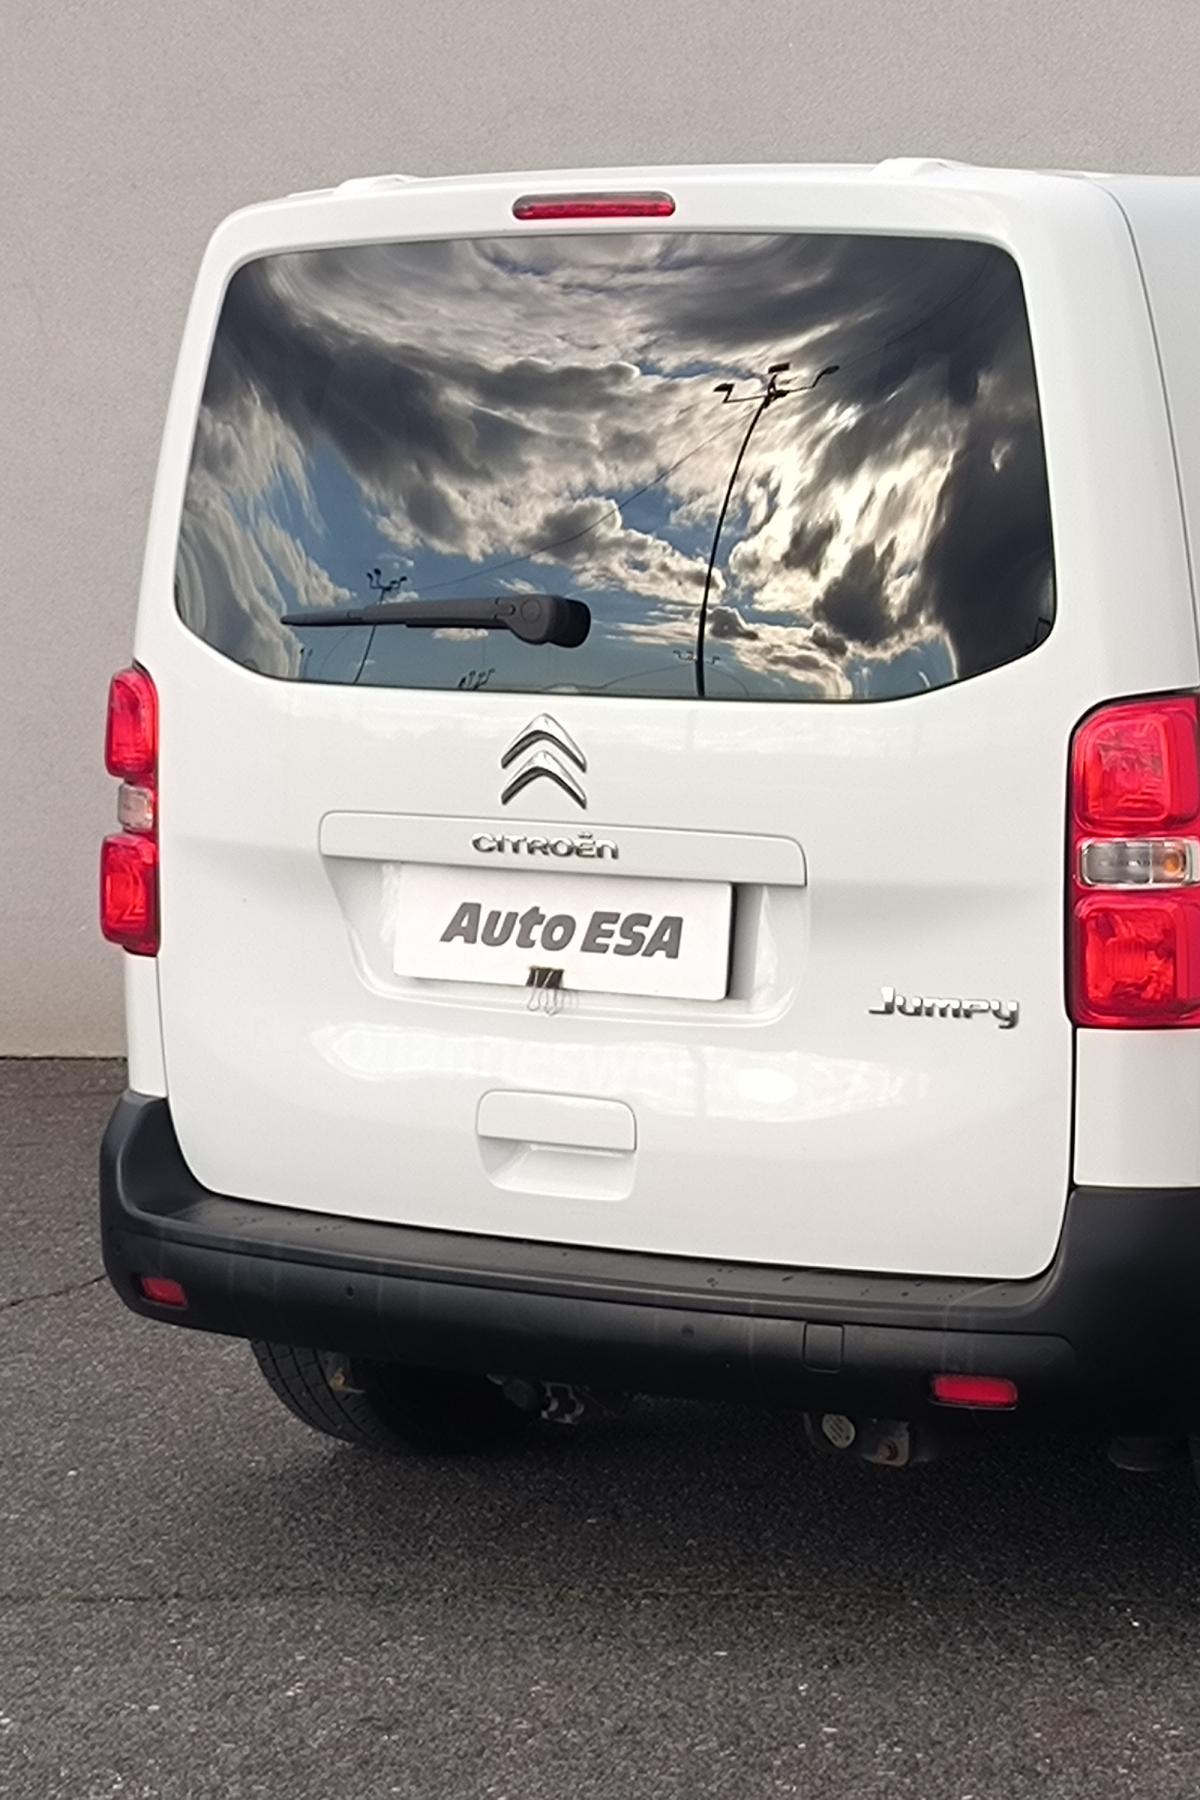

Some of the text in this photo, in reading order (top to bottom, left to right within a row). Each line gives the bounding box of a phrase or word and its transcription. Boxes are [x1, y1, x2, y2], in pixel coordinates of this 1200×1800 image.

[439, 902, 683, 959] Auto ESA
[868, 986, 1019, 1030] Jumpy
